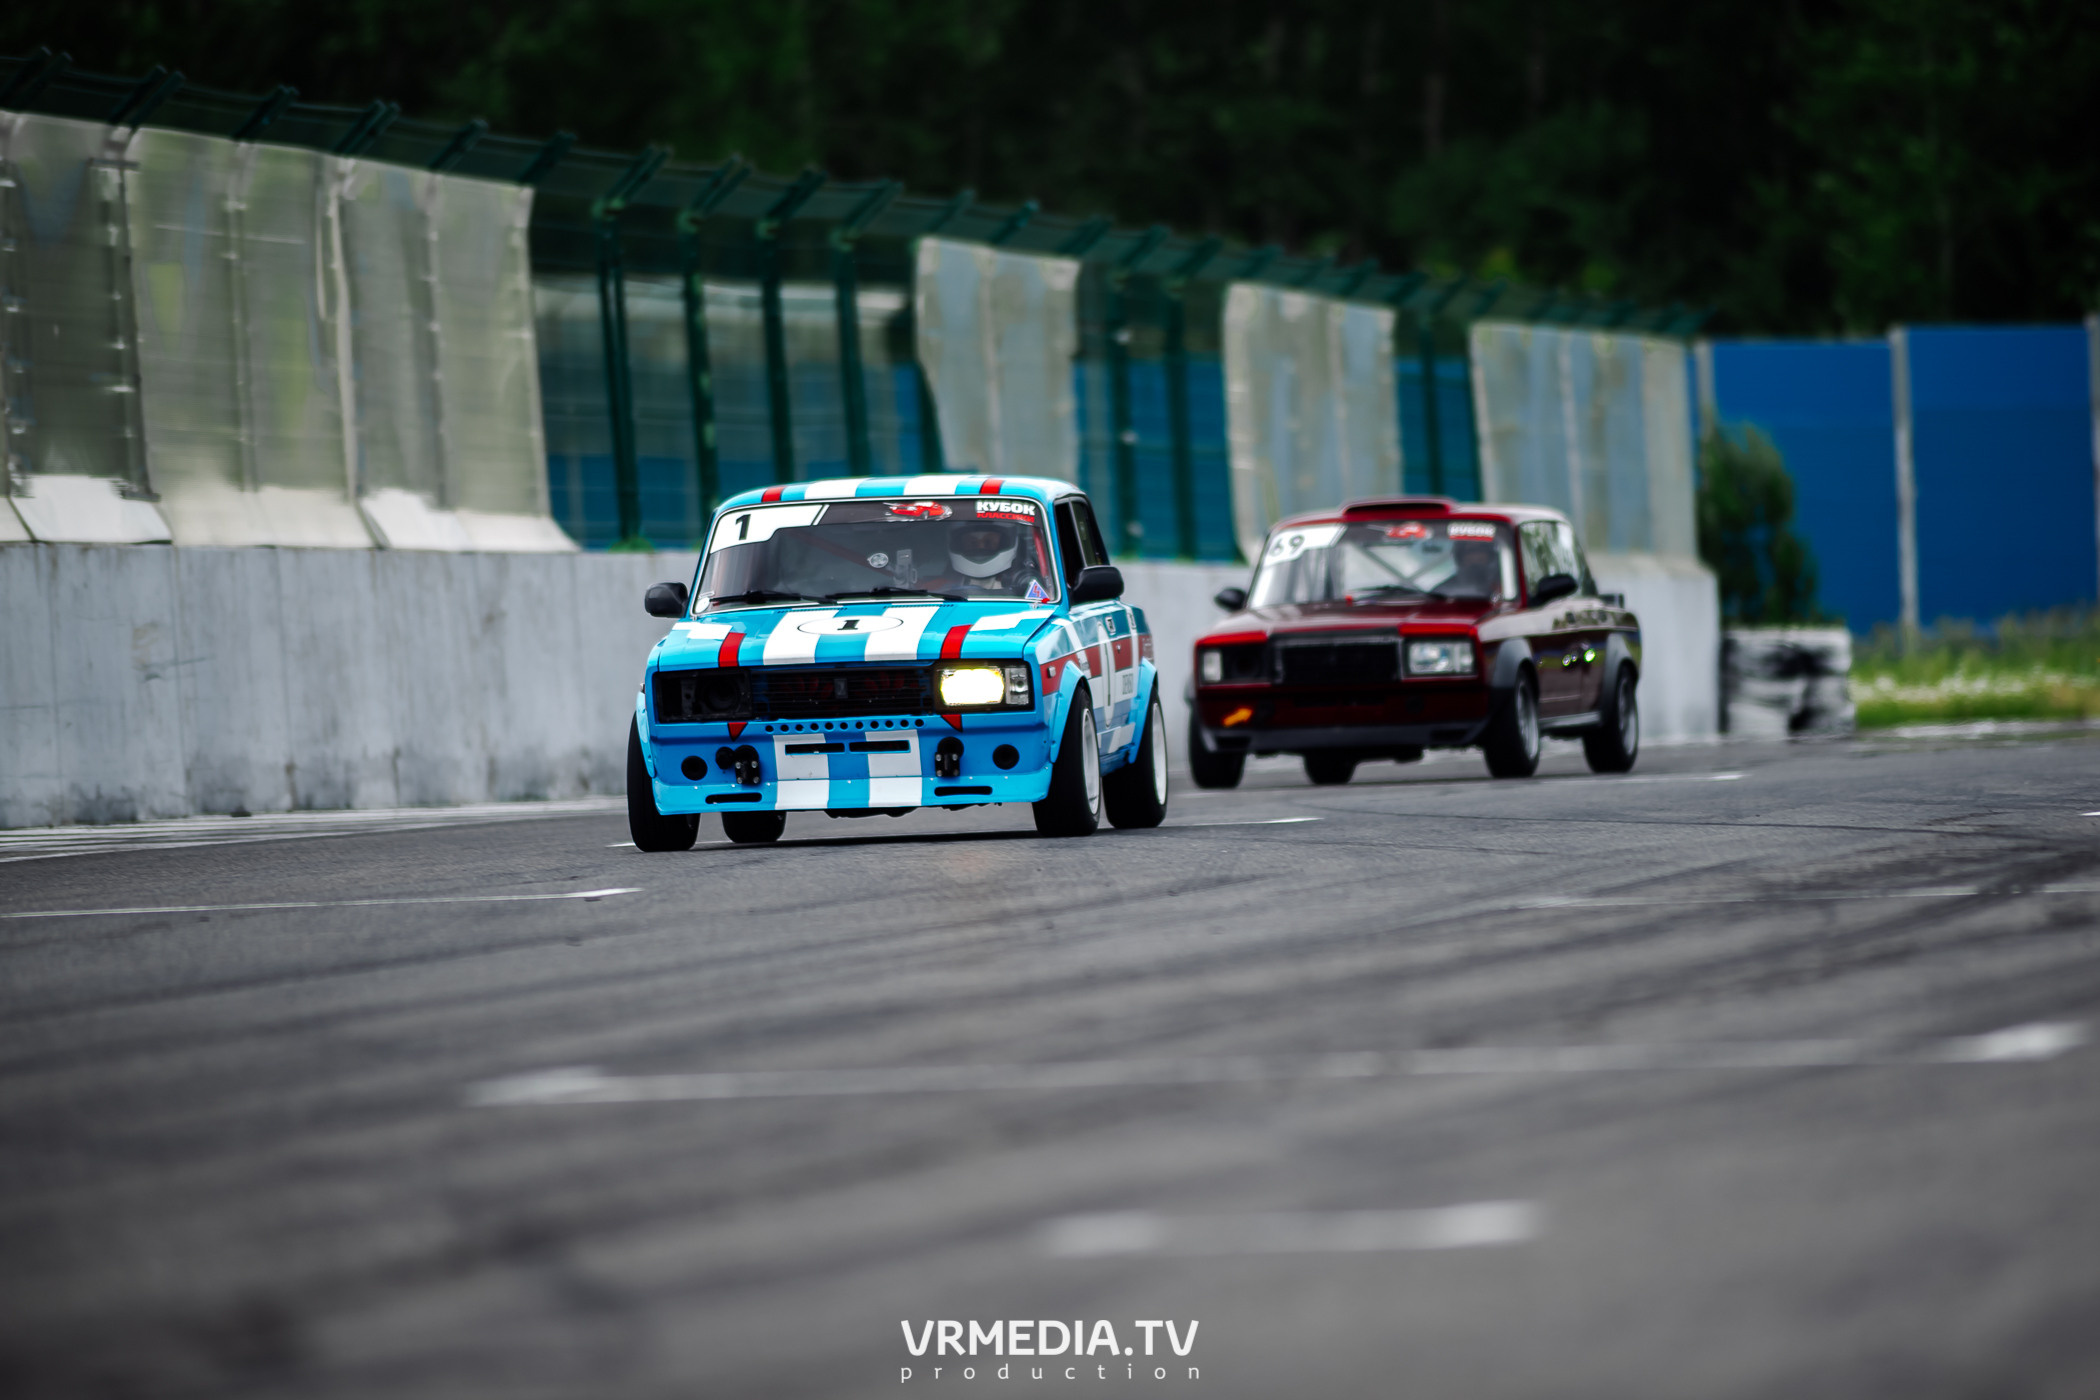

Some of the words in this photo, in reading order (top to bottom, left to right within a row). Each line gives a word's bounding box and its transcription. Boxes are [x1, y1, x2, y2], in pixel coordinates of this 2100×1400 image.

[976, 501, 1036, 516] КУБОК
[735, 513, 752, 542] 1
[1269, 534, 1306, 557] 69
[837, 619, 860, 631] 1
